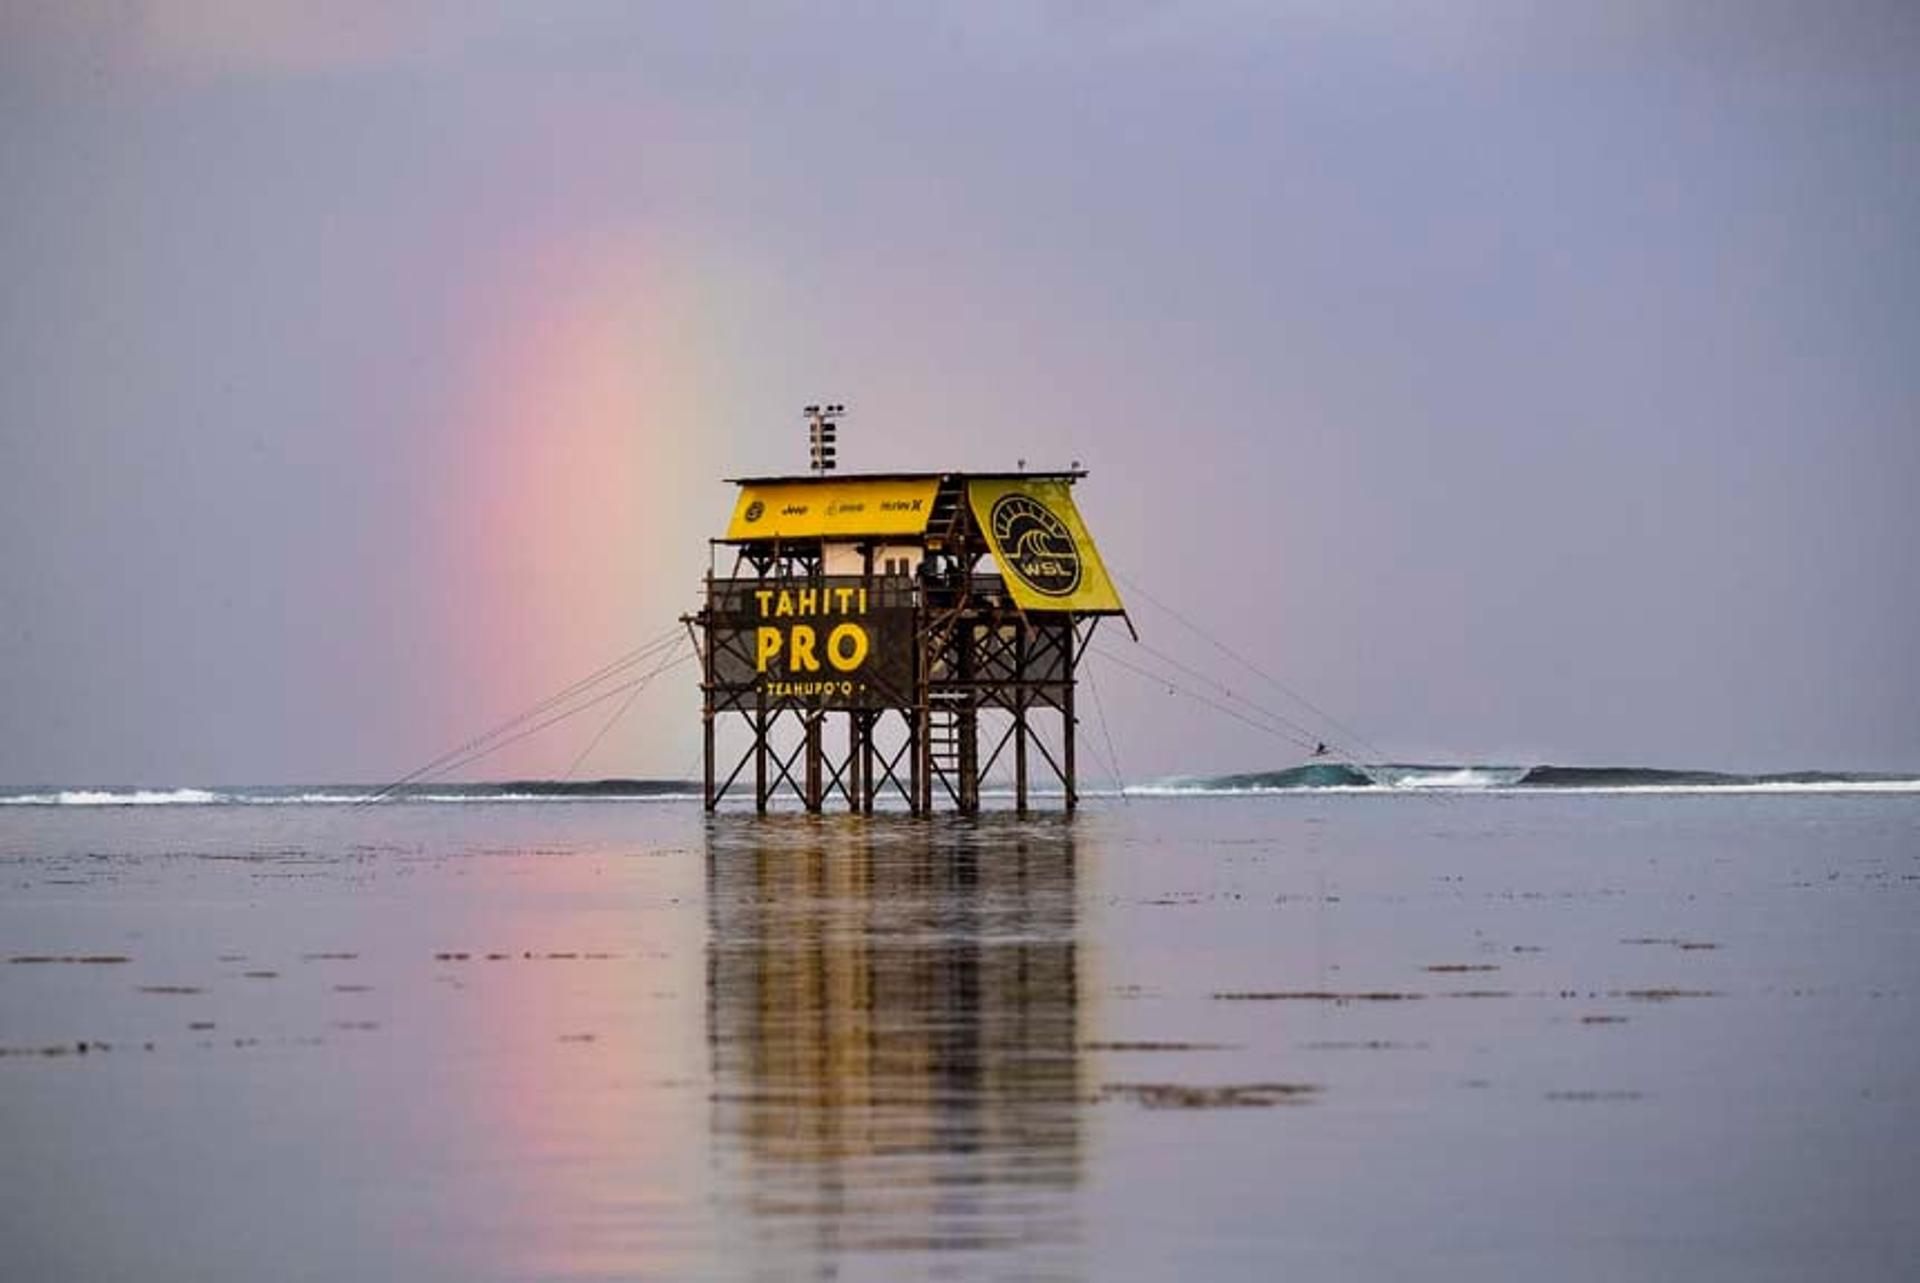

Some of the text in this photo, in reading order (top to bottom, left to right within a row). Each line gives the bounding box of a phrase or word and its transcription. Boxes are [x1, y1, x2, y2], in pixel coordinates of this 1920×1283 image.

[1022, 562, 1072, 576] WSL
[755, 588, 867, 617] TAHITI
[757, 623, 868, 672] PRO
